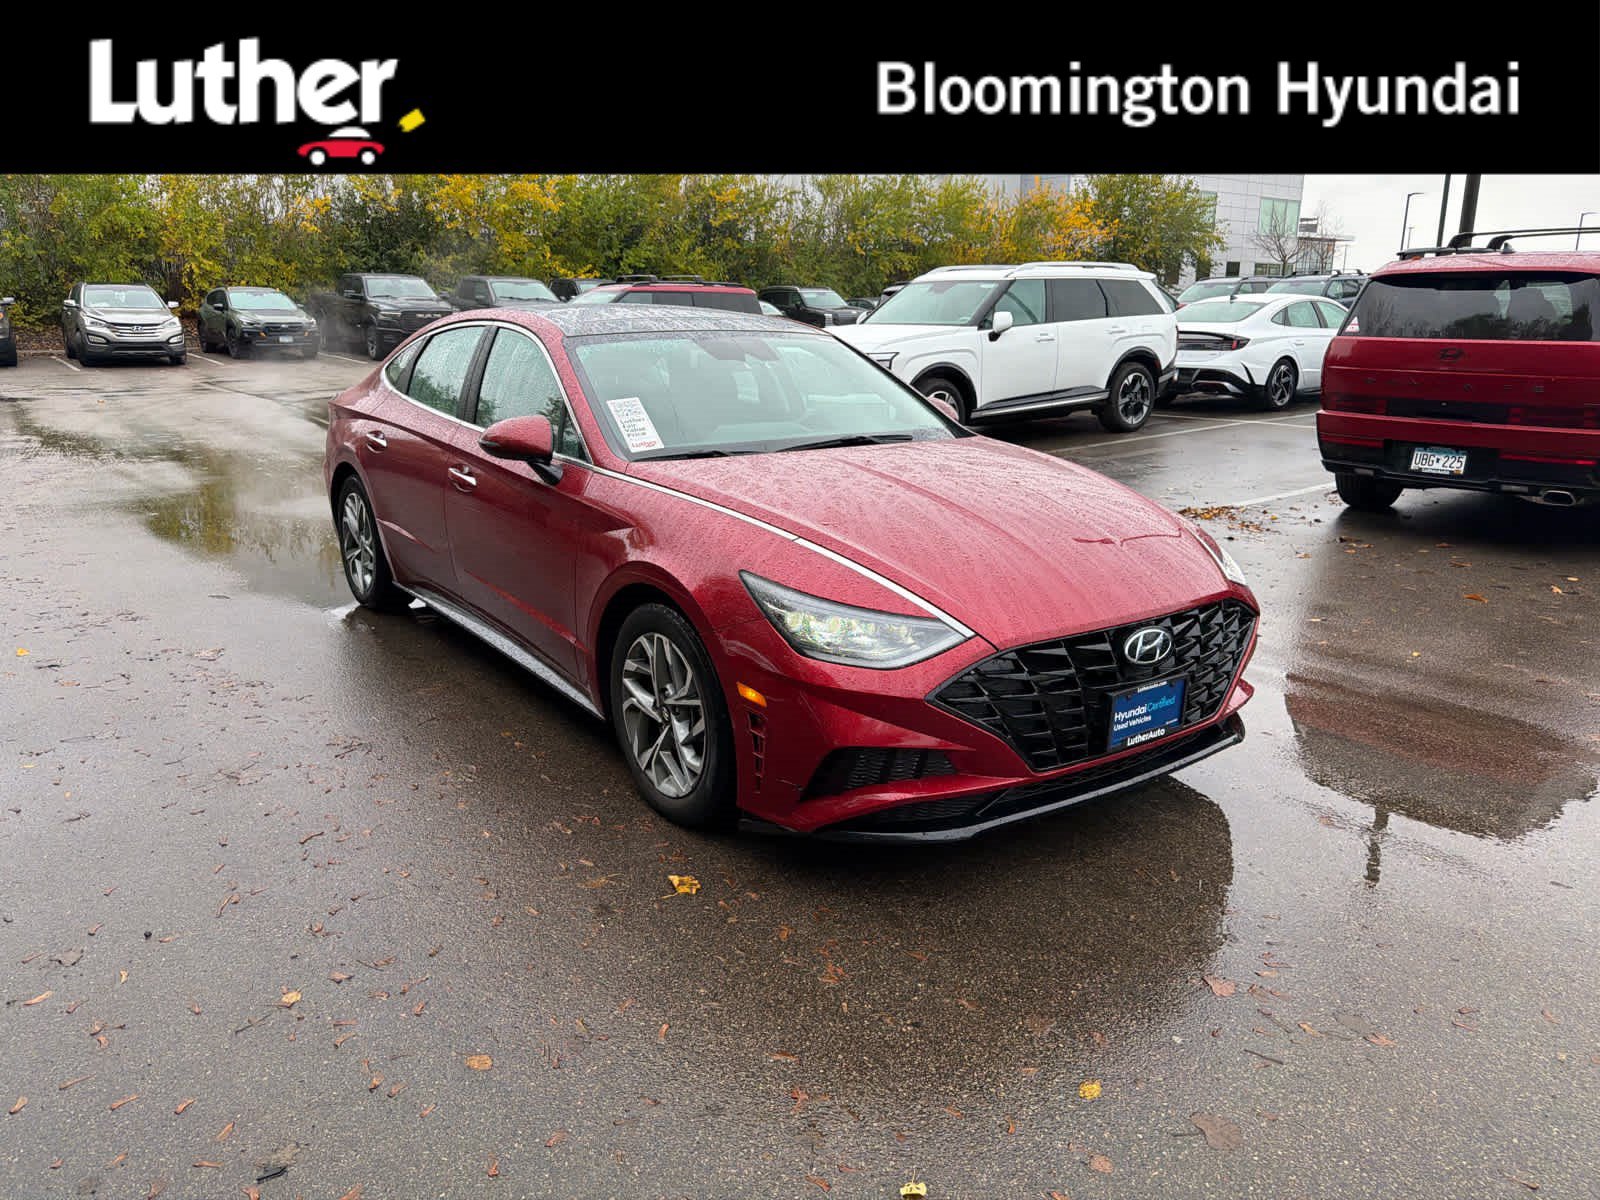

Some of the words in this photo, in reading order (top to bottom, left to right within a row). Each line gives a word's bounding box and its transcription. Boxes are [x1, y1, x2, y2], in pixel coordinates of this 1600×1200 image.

[1364, 376, 1473, 392] SNA
[1414, 452, 1436, 467] UBG
[1442, 455, 1465, 469] 225
[1114, 703, 1148, 722] Hyundai
[1113, 721, 1129, 732] Used
[1128, 714, 1152, 727] Vehicles
